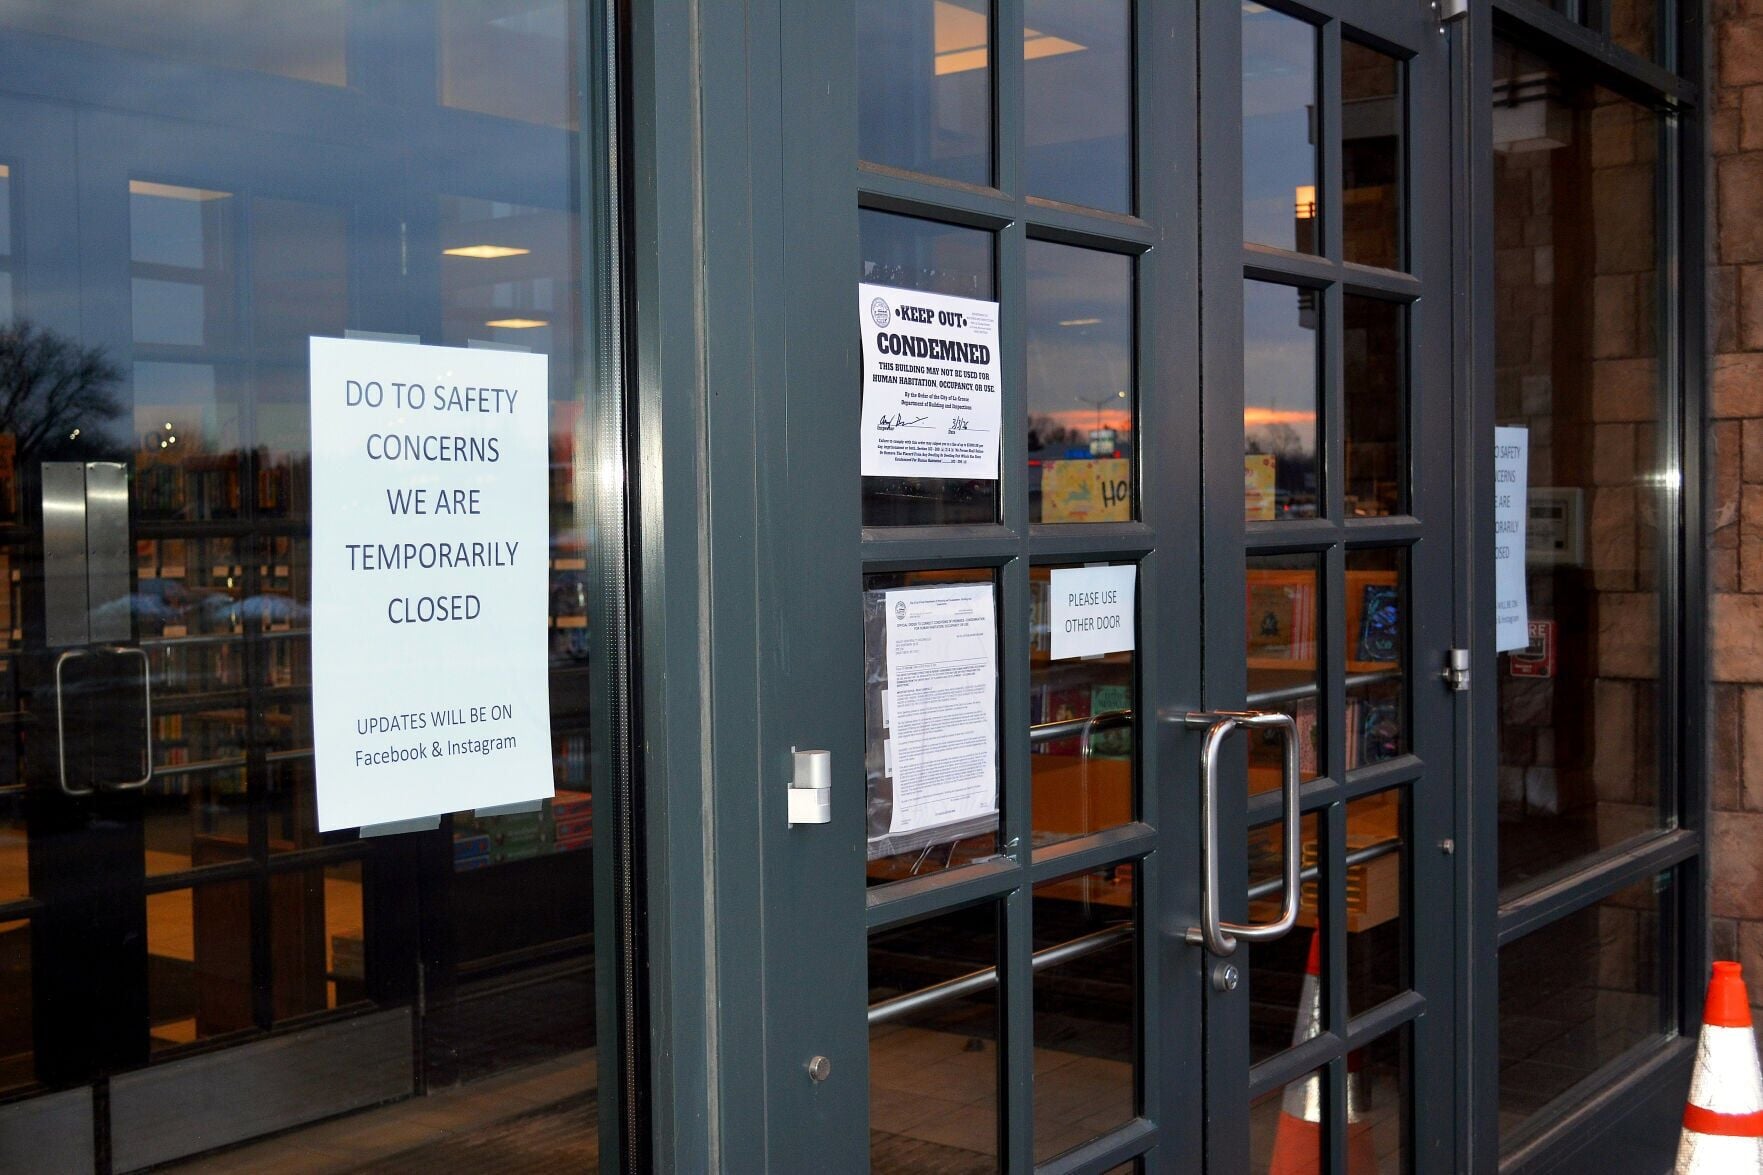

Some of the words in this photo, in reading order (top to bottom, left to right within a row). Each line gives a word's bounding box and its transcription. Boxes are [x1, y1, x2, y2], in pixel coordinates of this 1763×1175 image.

[877, 332, 990, 365] CONDEMNED
[873, 374, 897, 384] HUMAN
[879, 362, 893, 371] THIS
[895, 364, 925, 373] BUILDING
[926, 367, 939, 375] MAY
[941, 368, 953, 377] NOT
[964, 371, 977, 379] USED
[346, 380, 383, 408] DO
[392, 383, 425, 409] TO
[433, 385, 518, 413] SAFETY
[929, 401, 944, 409] Building
[367, 433, 500, 462] CONCERNS
[1501, 446, 1520, 459] SAFETY
[1495, 470, 1515, 482] CERNS
[386, 489, 427, 515] WE
[435, 489, 481, 515] ARE
[1499, 495, 1511, 508] ARE
[345, 542, 519, 571] TEMPORARILY
[1495, 546, 1509, 559] OSED
[1069, 592, 1099, 607] PLEASE
[1102, 591, 1117, 604] USE
[388, 595, 481, 624] CLOSED
[1065, 617, 1094, 632] OTHER
[1097, 615, 1120, 629] DOOR
[357, 712, 427, 735] UPDATES
[431, 709, 466, 727] WILL
[470, 706, 486, 723] BE
[491, 704, 512, 721] ON
[355, 742, 428, 767] Facebook
[431, 741, 443, 757] &
[448, 736, 517, 755] Instagram
